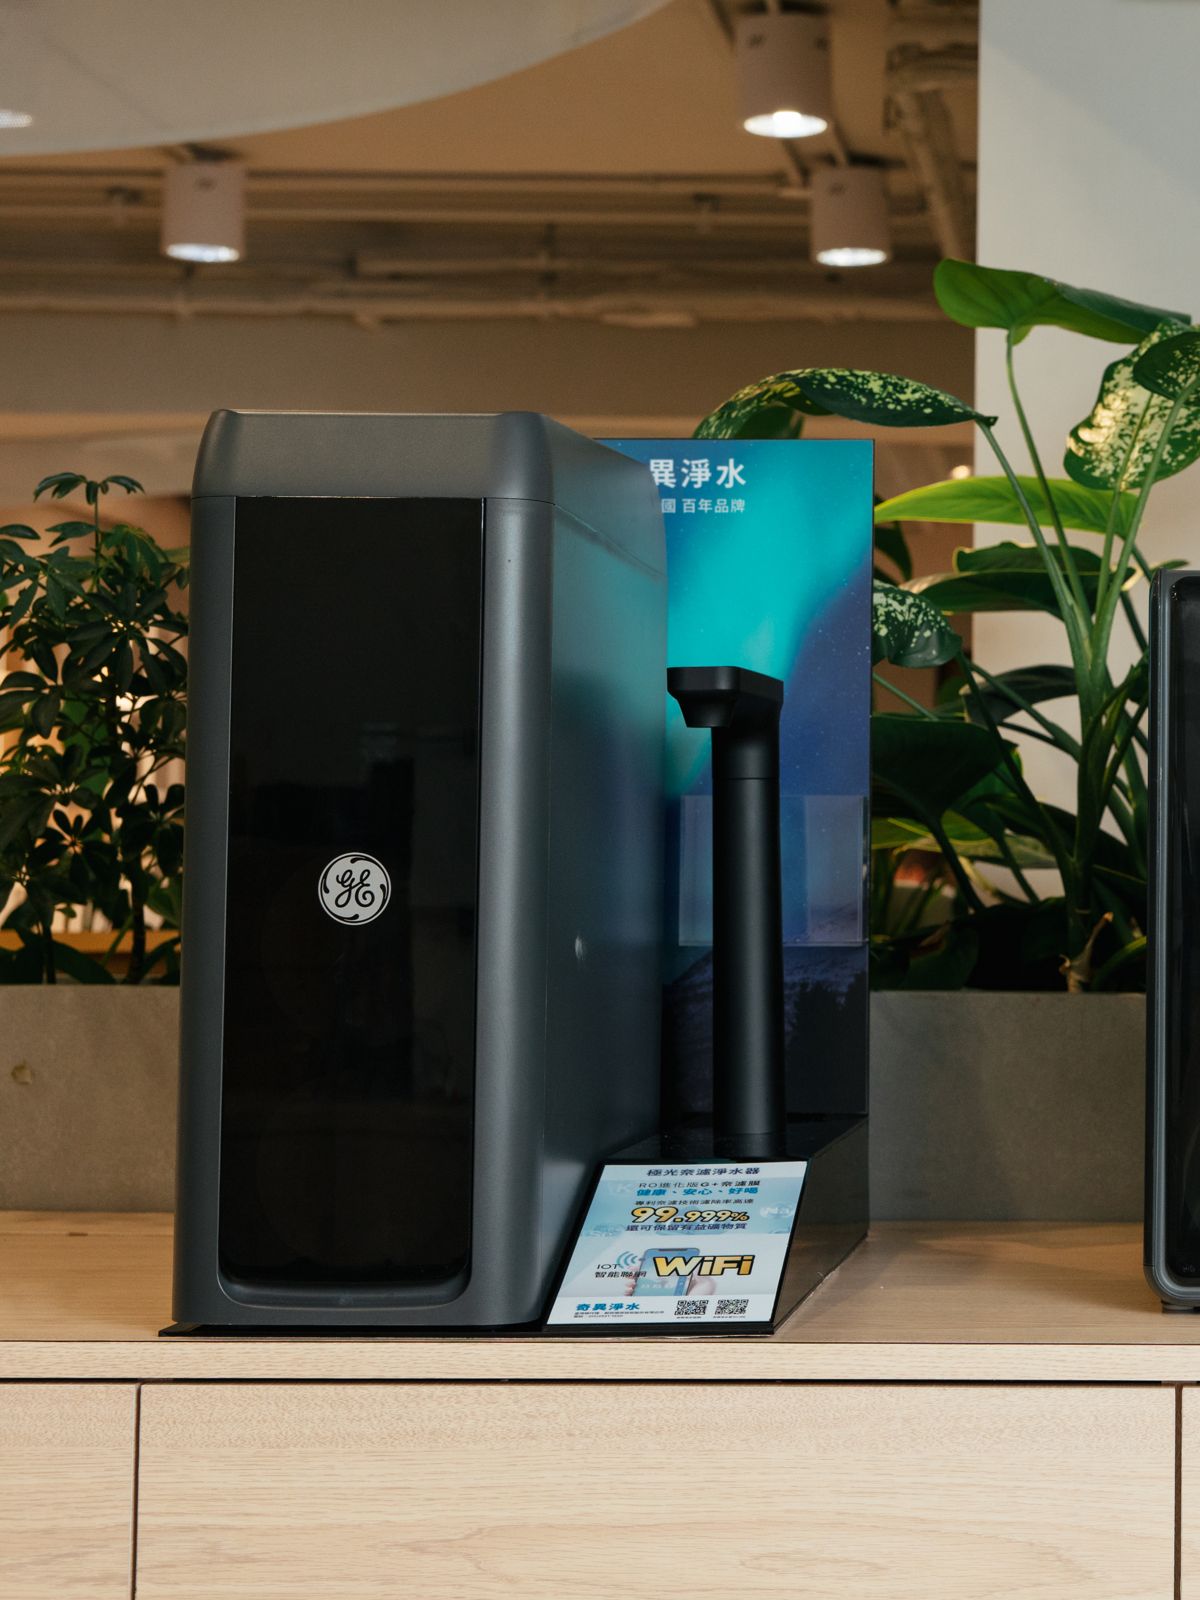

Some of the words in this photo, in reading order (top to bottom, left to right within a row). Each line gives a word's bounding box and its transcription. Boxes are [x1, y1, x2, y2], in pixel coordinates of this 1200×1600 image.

[650, 458, 746, 489] 異淨水
[682, 498, 745, 514] 百年品牌
[647, 1167, 760, 1177] 極光奈濾淨水器
[631, 1206, 750, 1223] 99.999%
[653, 1254, 755, 1277] WiFi
[576, 1302, 640, 1312] 奇異淨水
